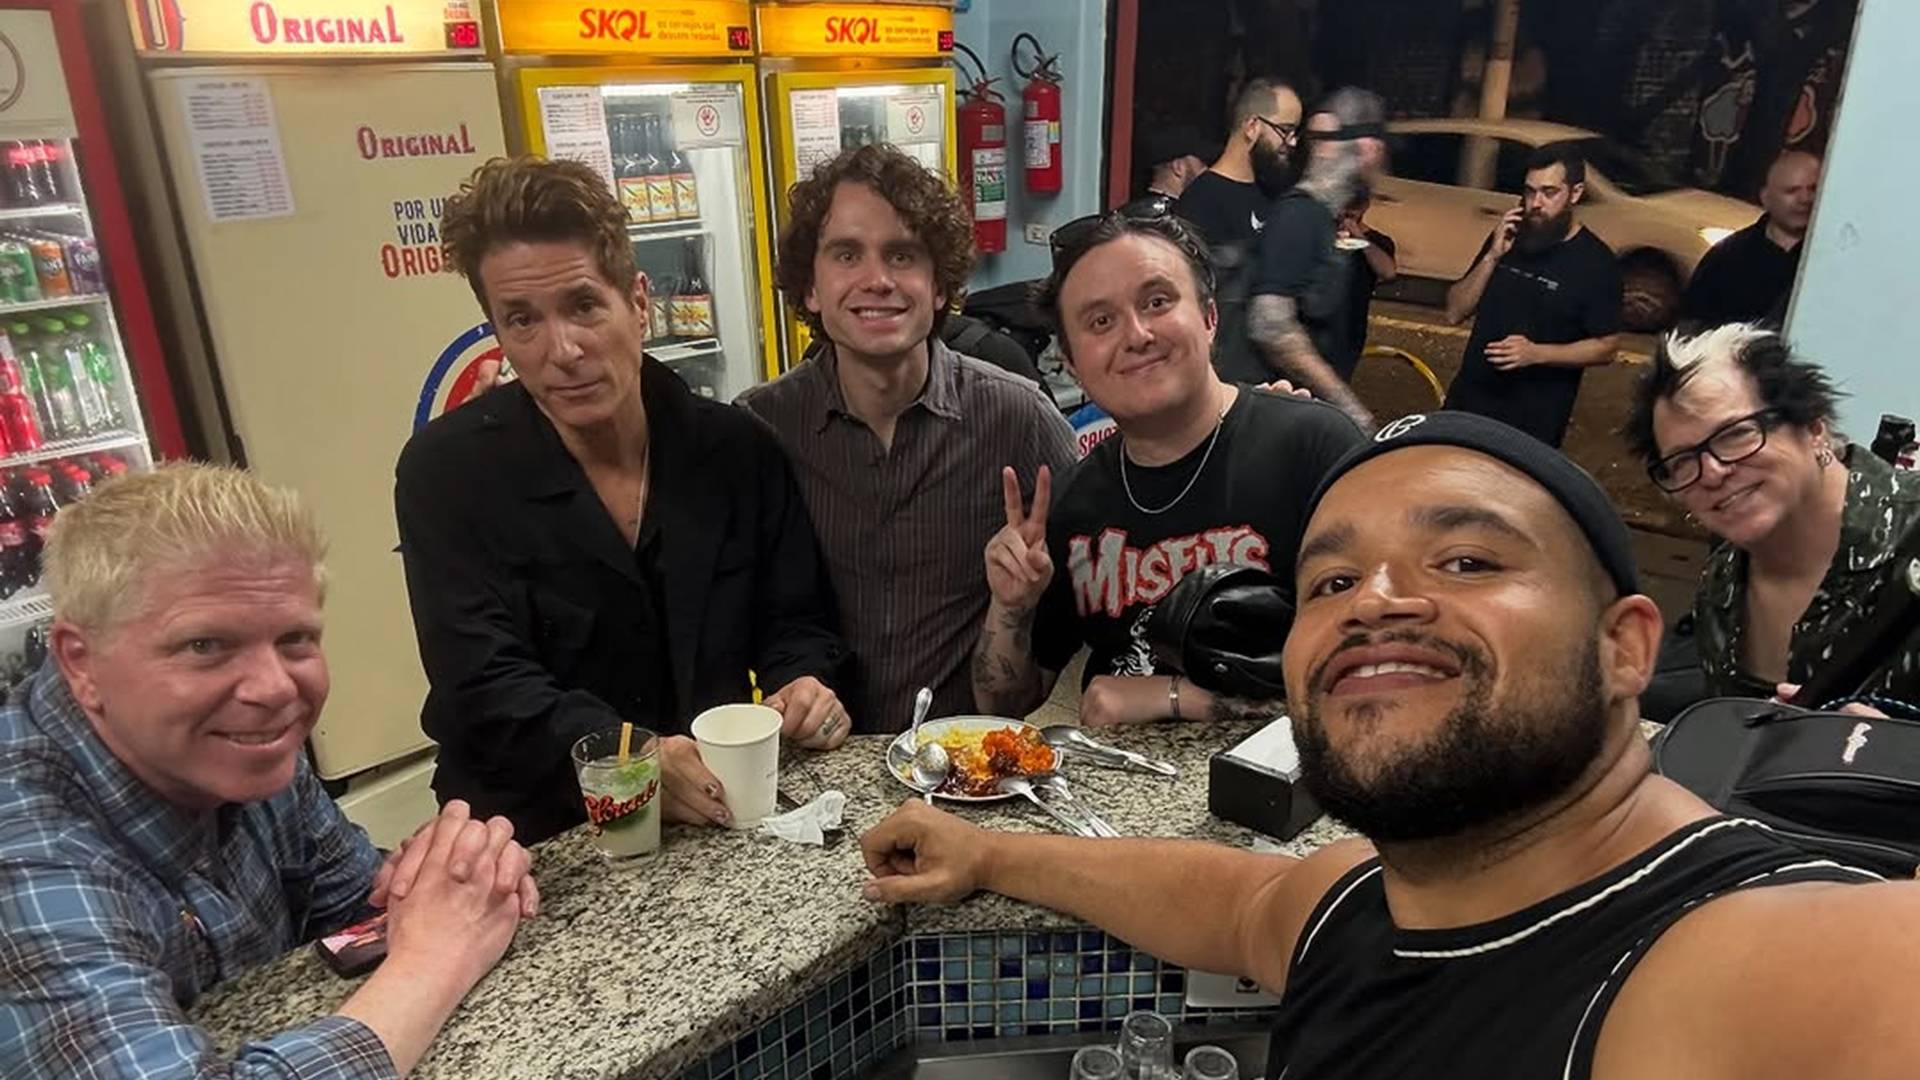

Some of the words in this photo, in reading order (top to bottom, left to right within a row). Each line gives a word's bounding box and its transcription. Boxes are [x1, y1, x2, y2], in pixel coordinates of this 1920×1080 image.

[250, 2, 404, 43] ORIGINAL
[580, 8, 651, 41] SKOL
[825, 16, 881, 45] SKOL
[357, 124, 476, 160] ORIGINAL
[394, 199, 425, 220] POR
[397, 223, 439, 245] VIDA
[381, 244, 442, 278] ORIG
